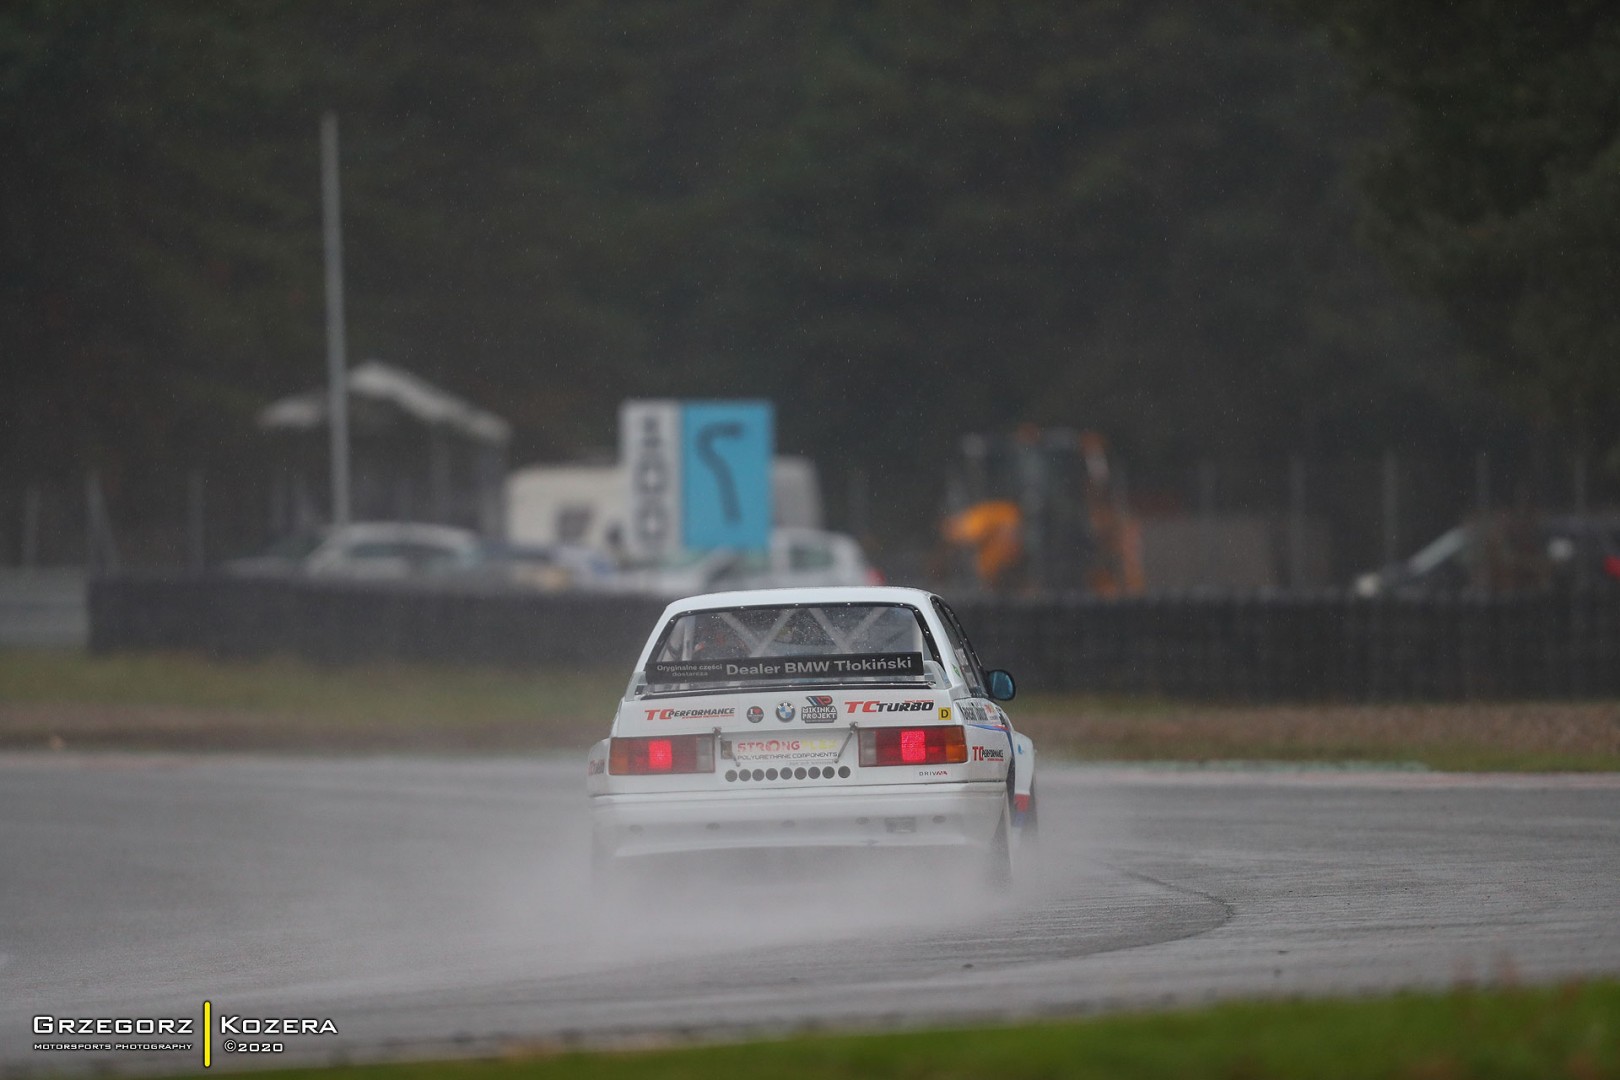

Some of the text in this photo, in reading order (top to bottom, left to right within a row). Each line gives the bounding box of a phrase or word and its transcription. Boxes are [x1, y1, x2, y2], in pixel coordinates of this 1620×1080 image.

[726, 656, 913, 676] Dealer BMW Tłokiński
[941, 709, 949, 718] D
[792, 751, 838, 759] COMPONENTS
